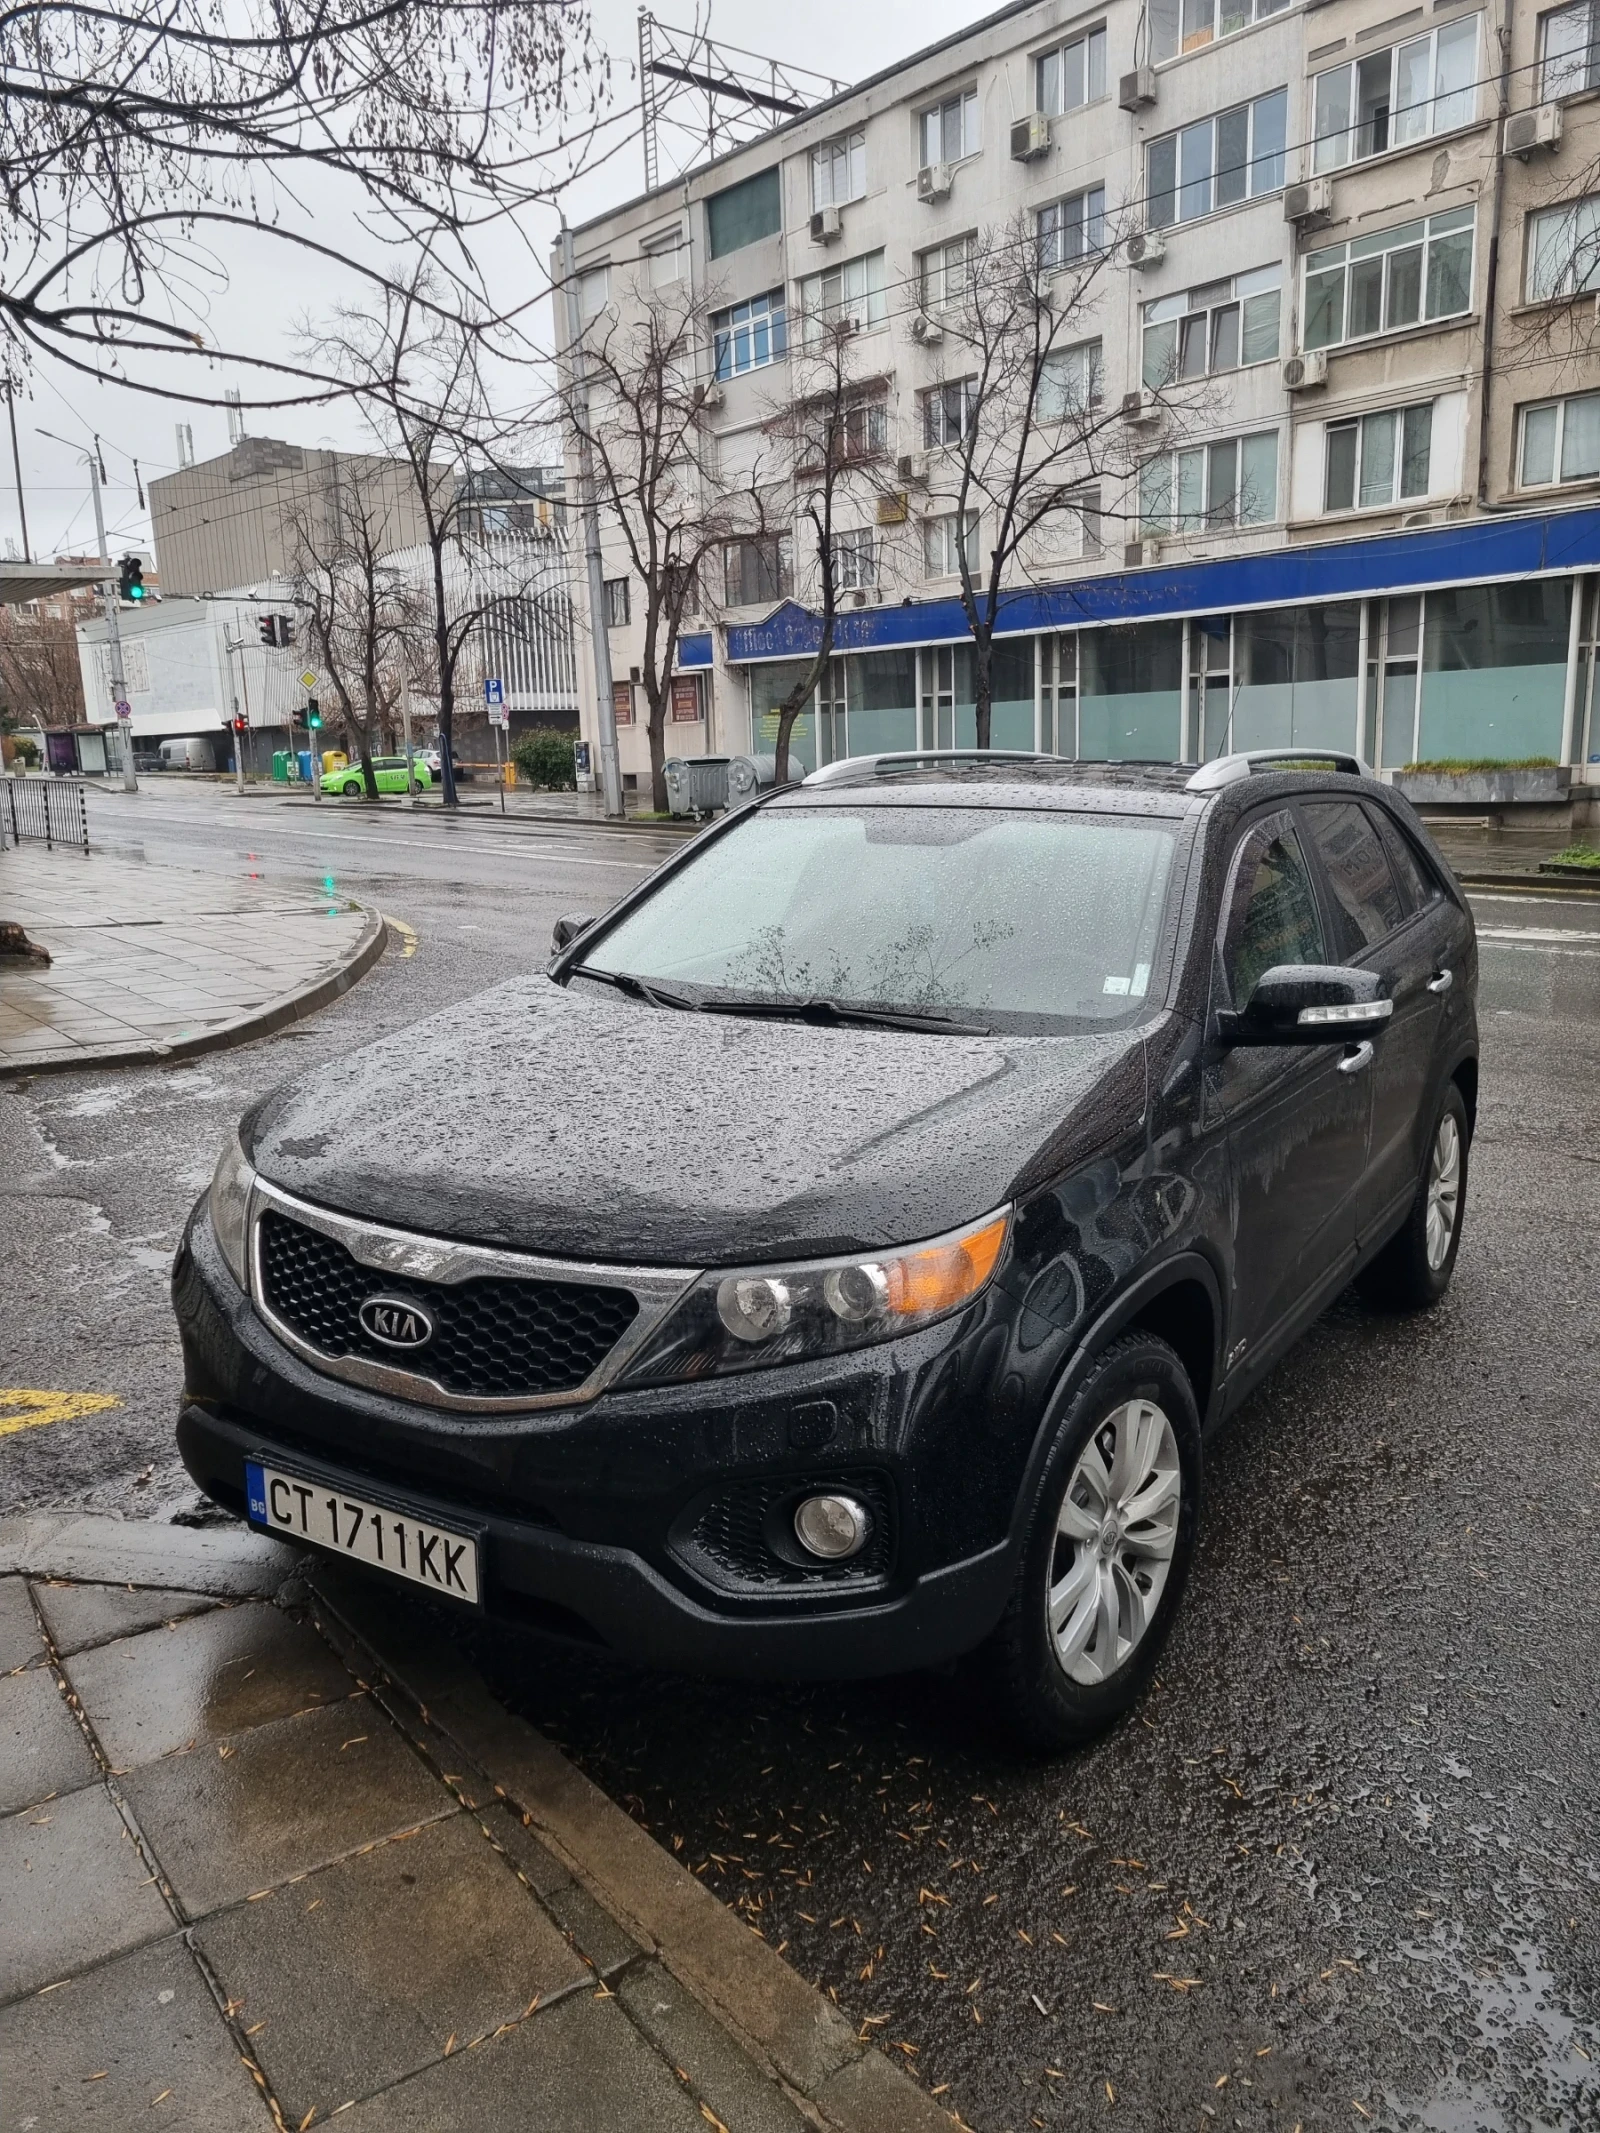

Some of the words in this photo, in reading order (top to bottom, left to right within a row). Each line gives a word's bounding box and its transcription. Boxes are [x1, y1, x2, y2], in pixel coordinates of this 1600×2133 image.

[490, 681, 497, 692] P
[374, 1307, 417, 1340] KIA
[251, 1498, 265, 1514] BG
